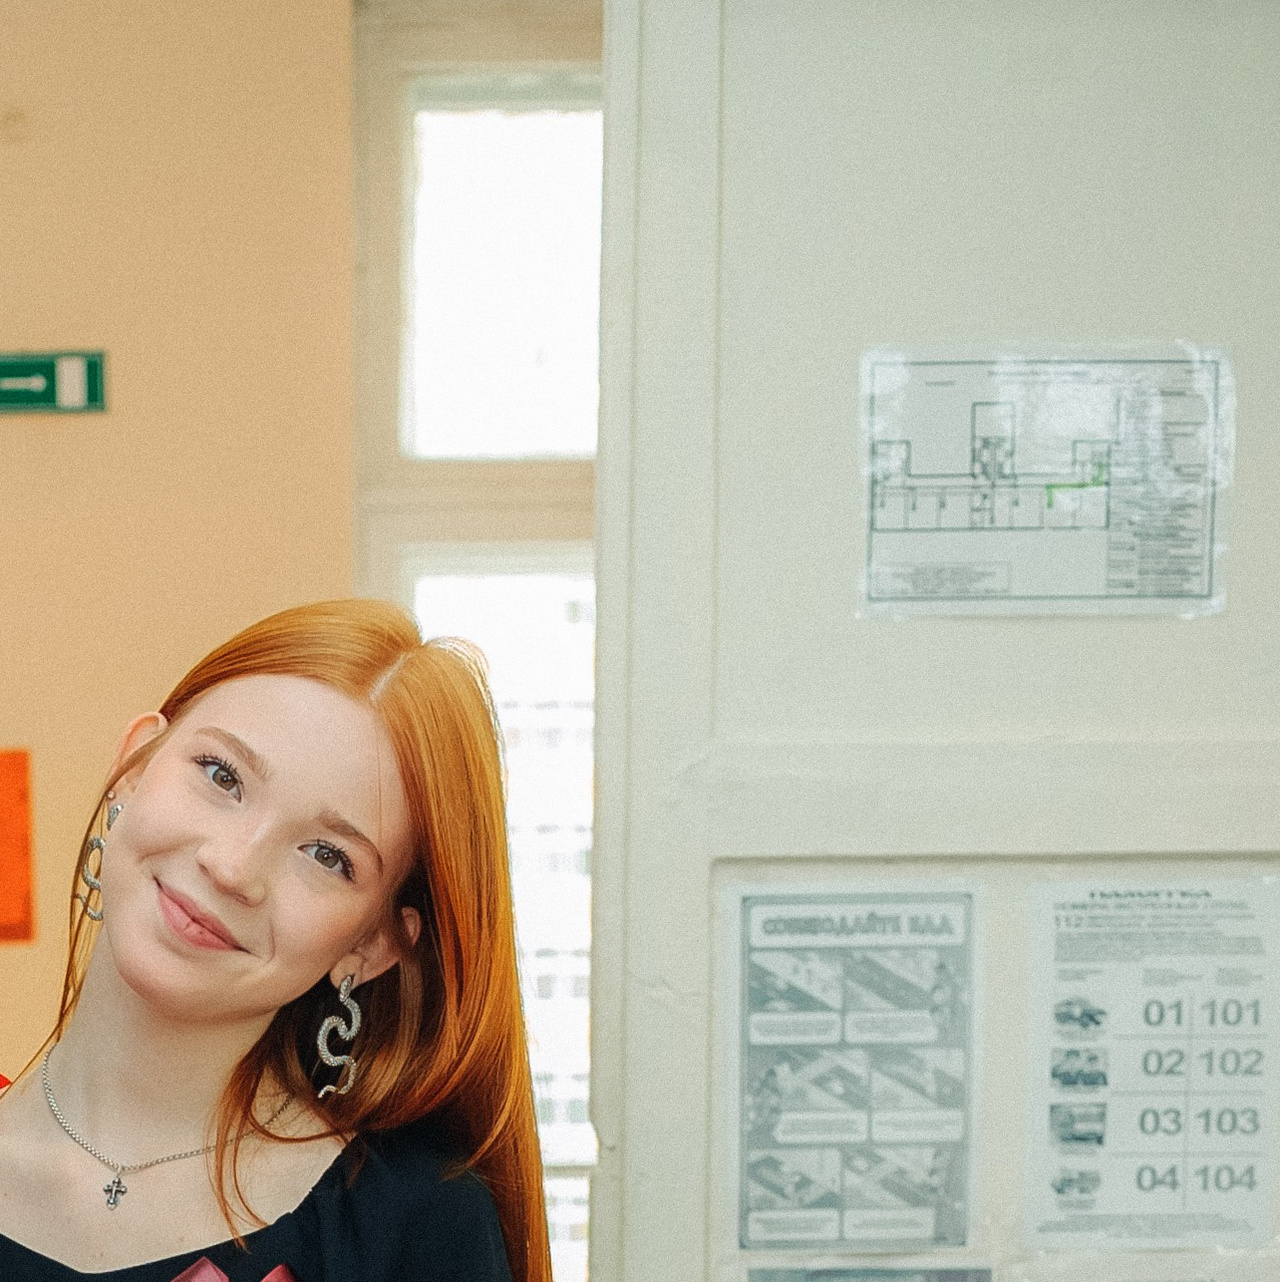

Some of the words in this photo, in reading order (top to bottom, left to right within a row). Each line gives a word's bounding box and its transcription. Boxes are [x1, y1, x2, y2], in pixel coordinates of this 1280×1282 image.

[1143, 1000, 1183, 1026] 01
[1200, 1000, 1262, 1026] 101
[1142, 1049, 1185, 1077] 02
[1199, 1049, 1264, 1077] 102
[1139, 1108, 1182, 1136] 03
[1197, 1108, 1260, 1136] 103
[1136, 1165, 1180, 1192] 04
[1194, 1165, 1258, 1192] 104
